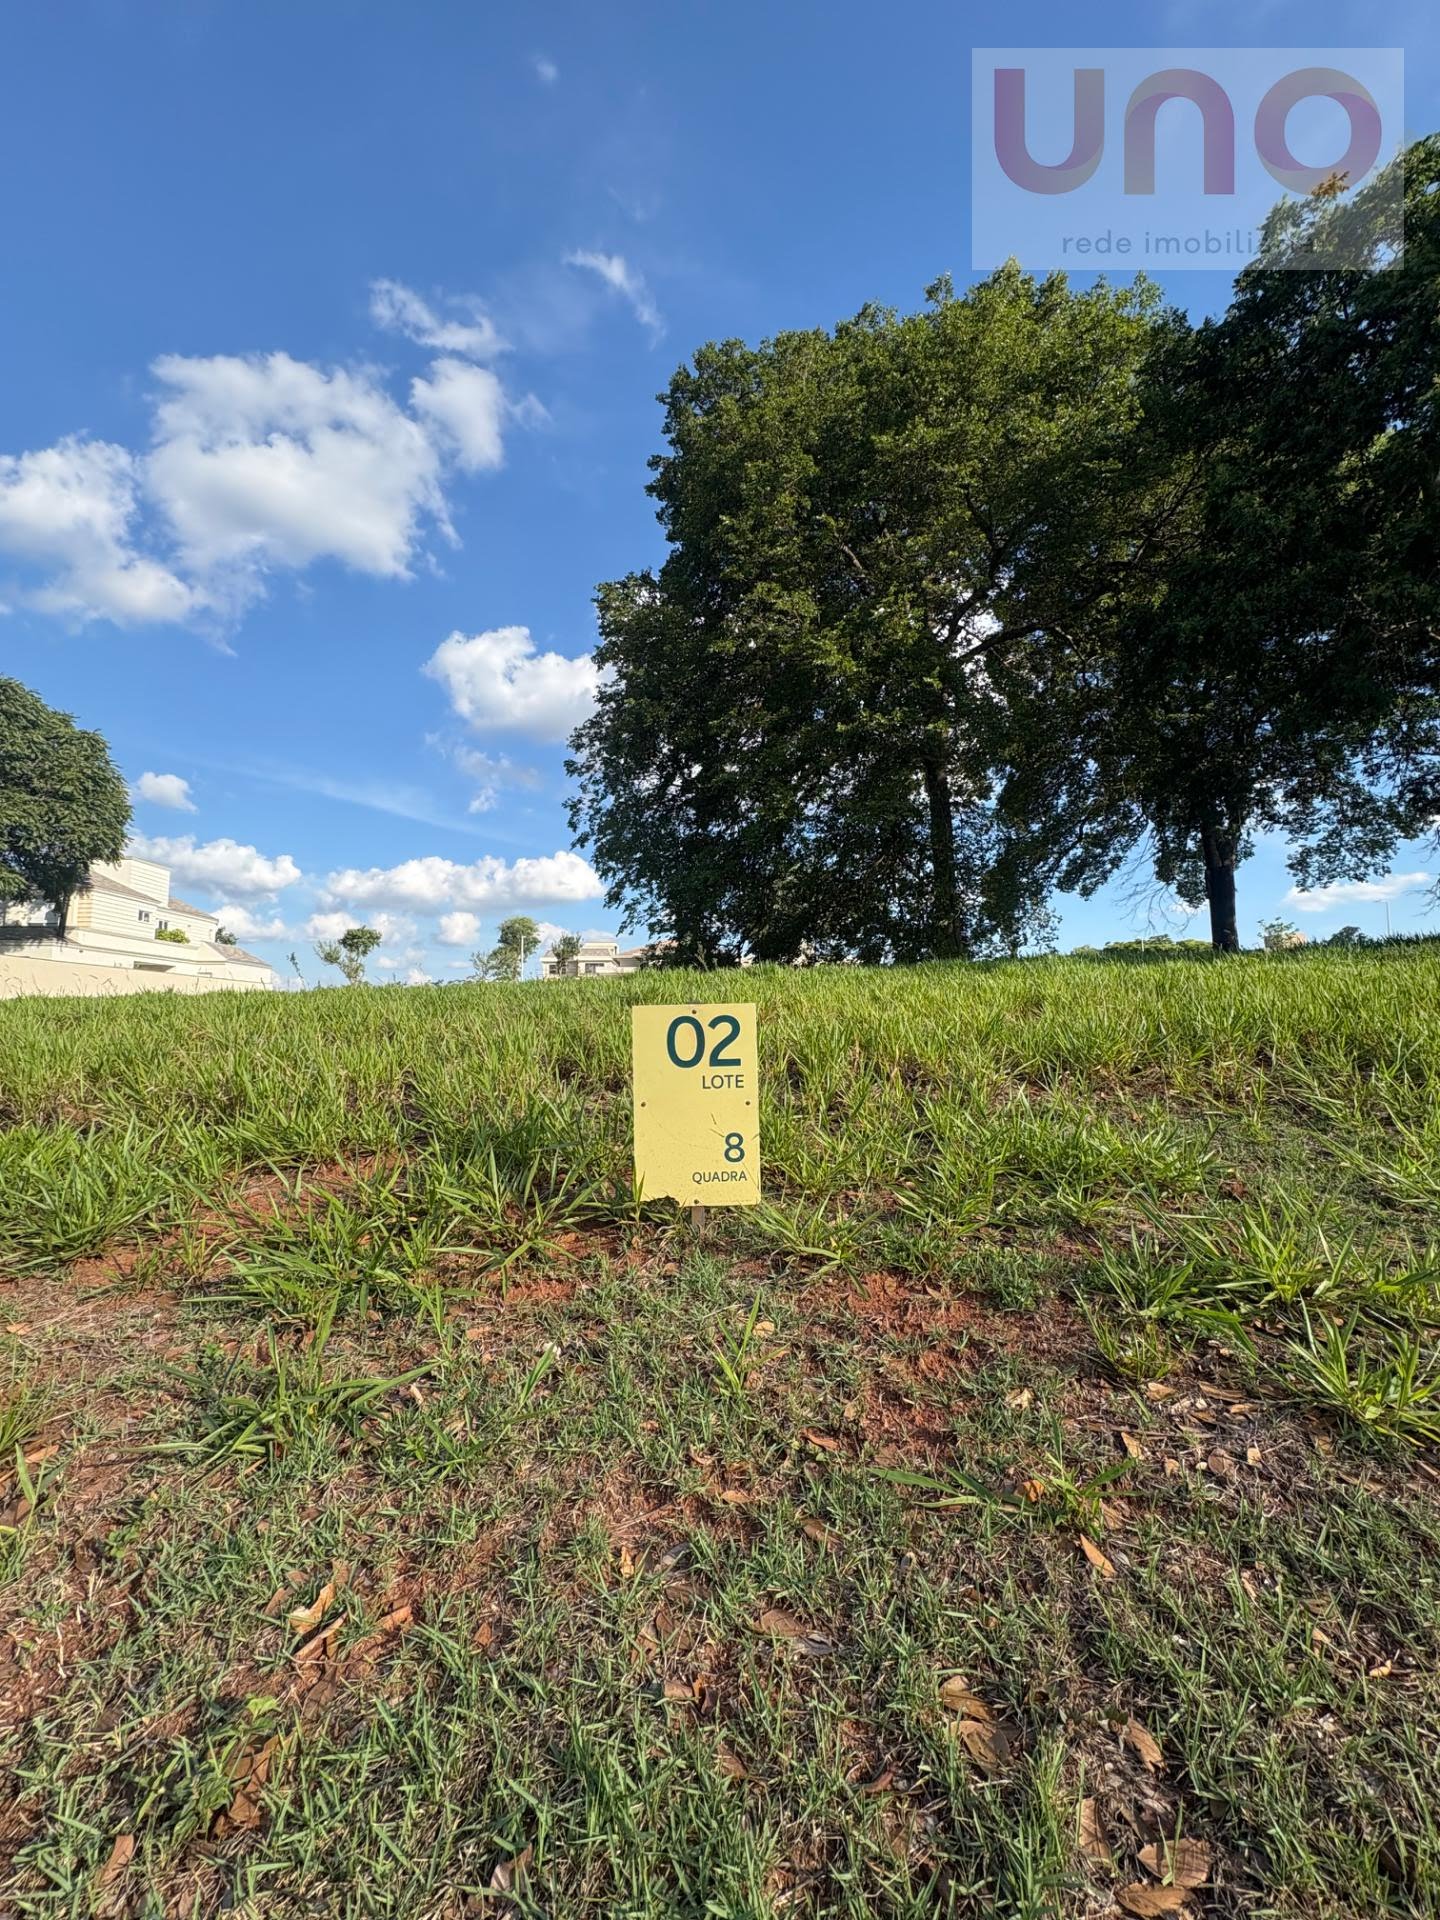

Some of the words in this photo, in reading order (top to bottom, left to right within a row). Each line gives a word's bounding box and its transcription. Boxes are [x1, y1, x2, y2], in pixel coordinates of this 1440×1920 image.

[666, 1014, 742, 1069] 02
[702, 1074, 745, 1090] LOTE
[724, 1132, 745, 1163] 8
[692, 1170, 747, 1185] QUADRA
